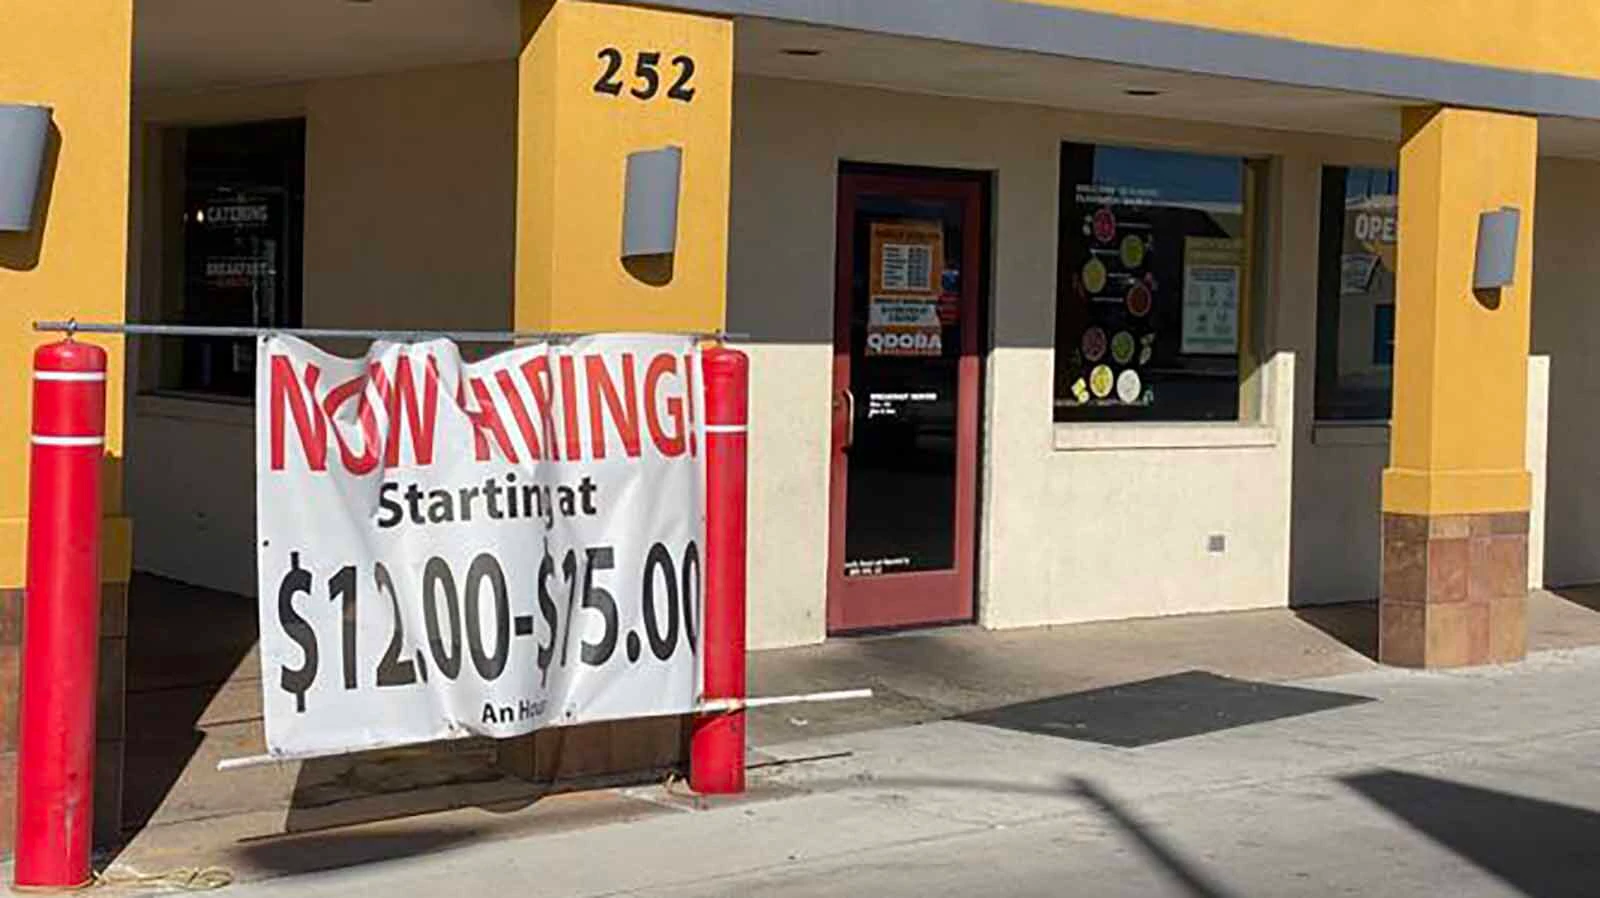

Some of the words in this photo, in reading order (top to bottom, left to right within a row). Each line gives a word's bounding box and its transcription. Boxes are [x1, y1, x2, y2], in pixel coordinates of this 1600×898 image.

[593, 48, 696, 102] 252
[867, 333, 942, 352] QDOBA
[270, 353, 439, 475] NOW
[456, 353, 697, 464] HIRING!
[557, 476, 597, 517] at
[278, 535, 701, 713] $12.00-$15.00
[482, 703, 514, 723] An
